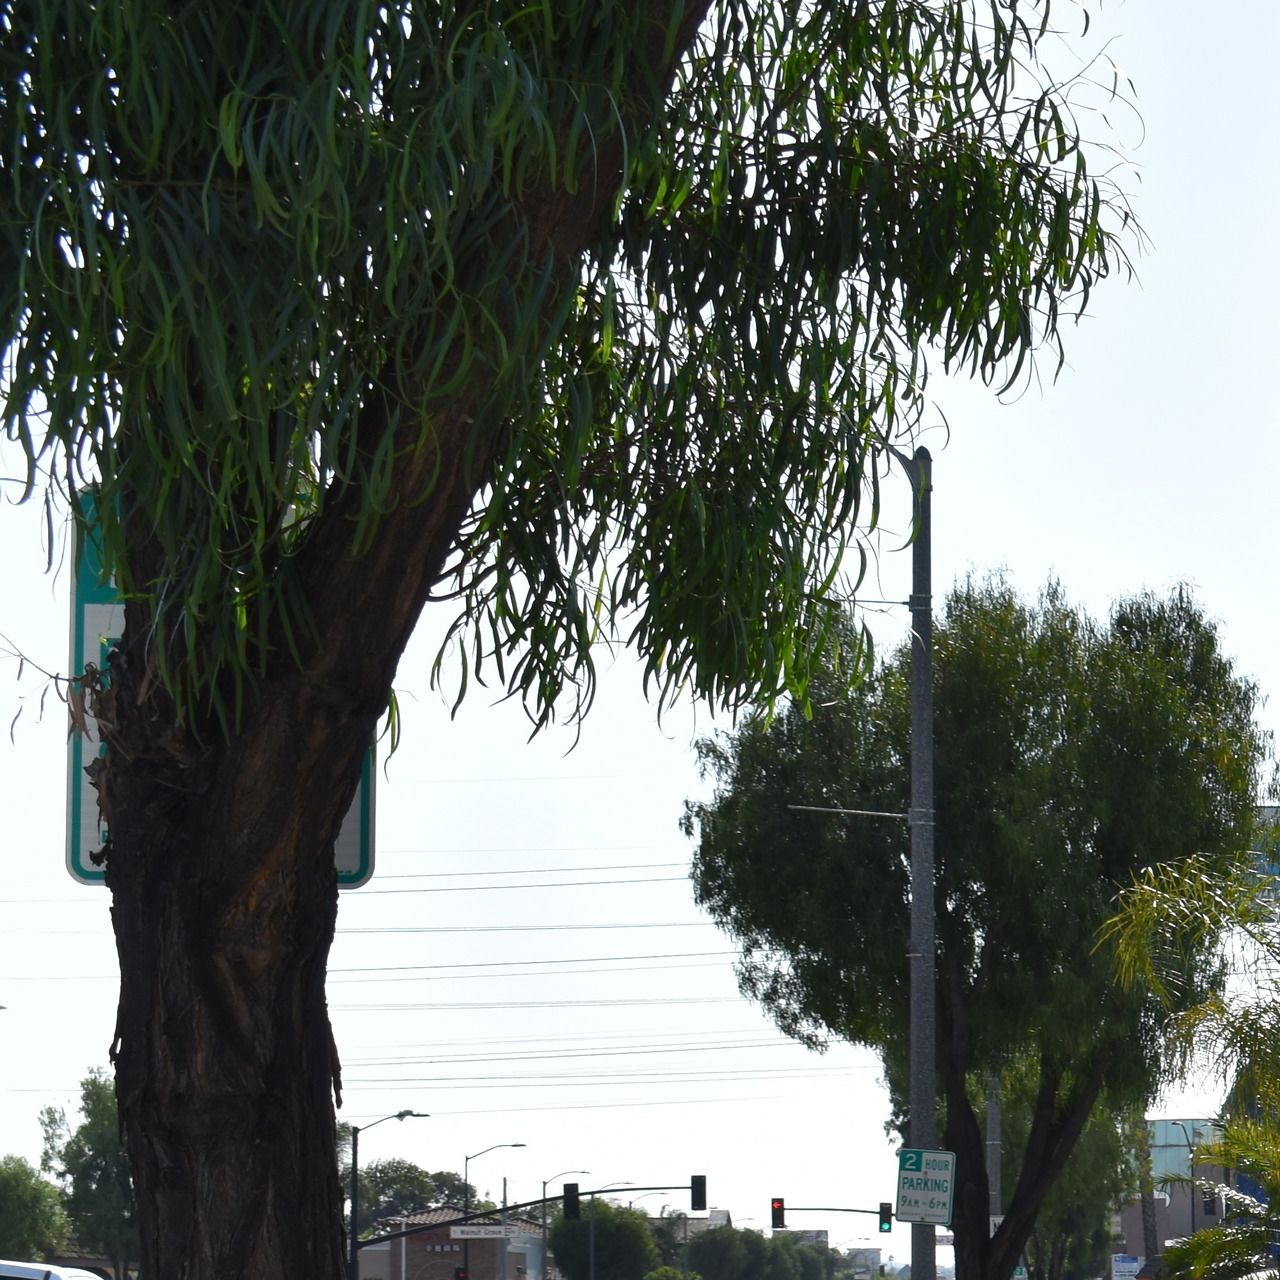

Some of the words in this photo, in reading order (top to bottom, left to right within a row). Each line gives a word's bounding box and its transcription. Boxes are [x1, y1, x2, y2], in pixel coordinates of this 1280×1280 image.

[905, 1153, 917, 1169] 2
[925, 1159, 950, 1171] HOUR
[902, 1177, 949, 1192] PARKING
